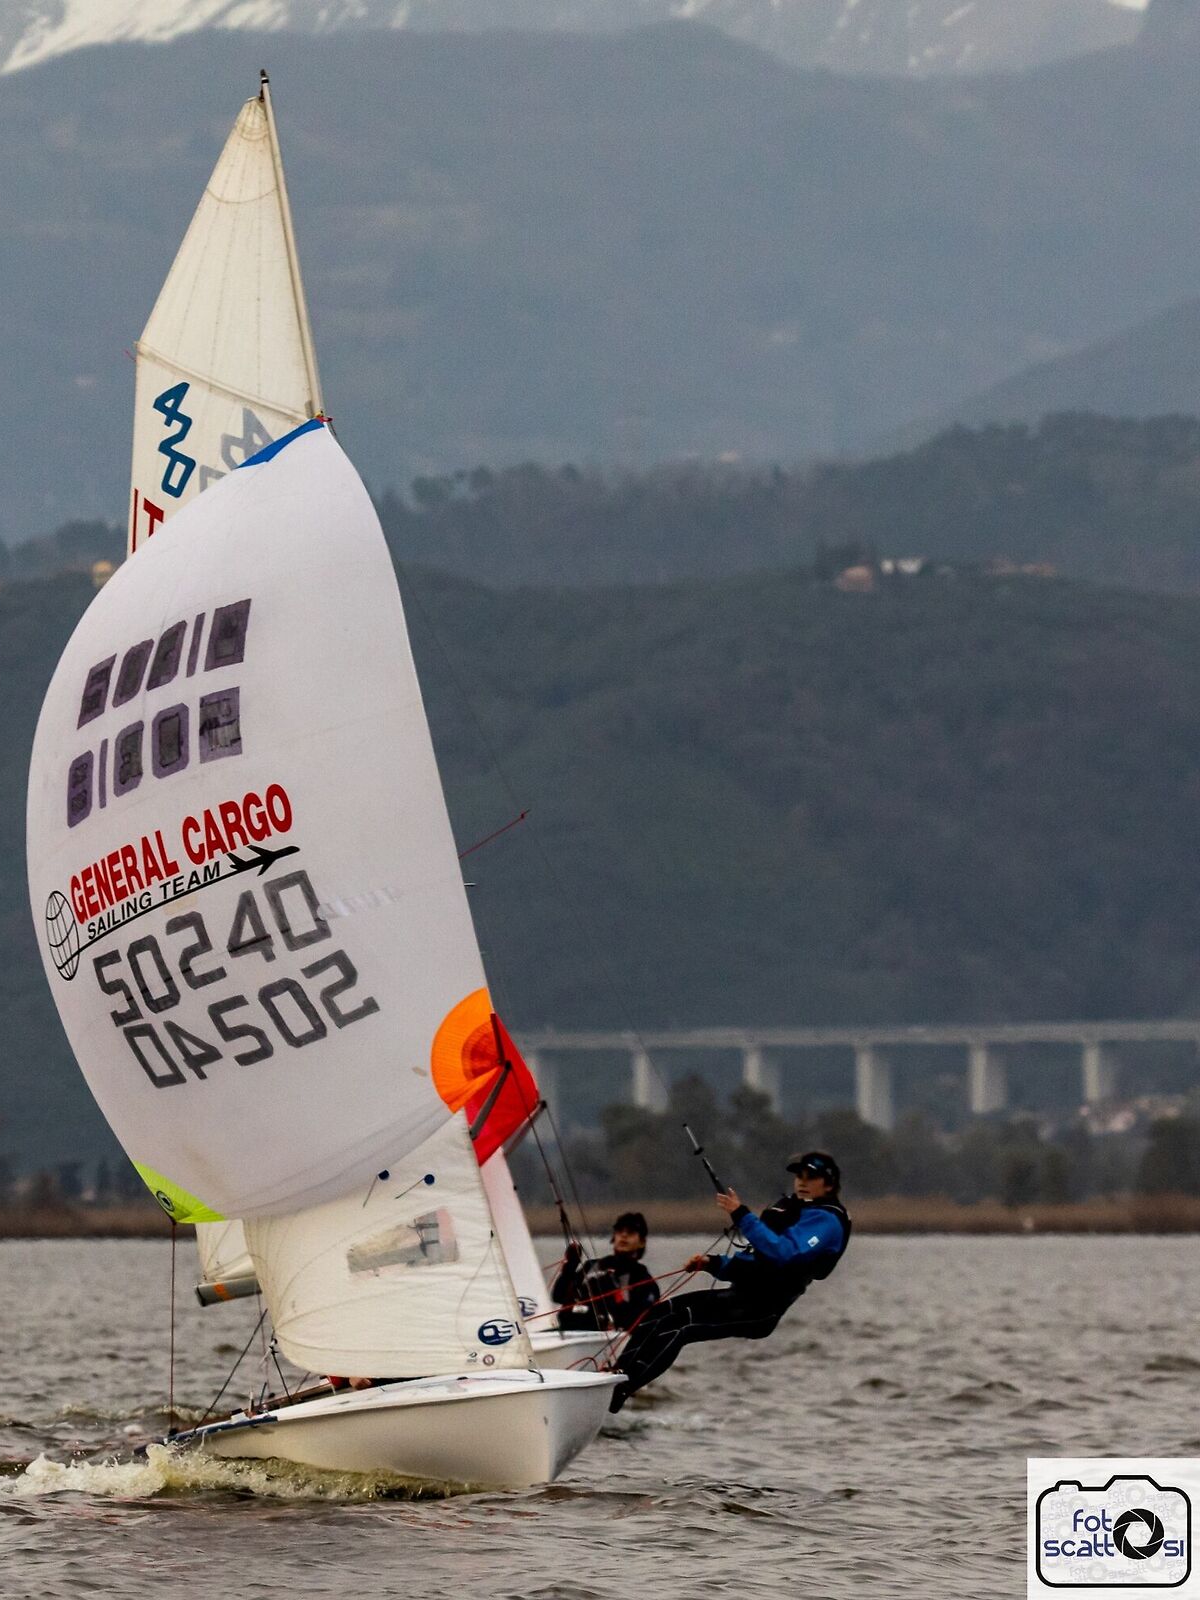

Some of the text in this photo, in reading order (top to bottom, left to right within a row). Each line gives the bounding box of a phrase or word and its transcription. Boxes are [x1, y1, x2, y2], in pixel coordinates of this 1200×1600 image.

[153, 382, 196, 498] 420
[70, 784, 293, 925] GENERAL CARGO
[87, 861, 221, 940] SAILING TEAM
[93, 870, 332, 1027] 50240
